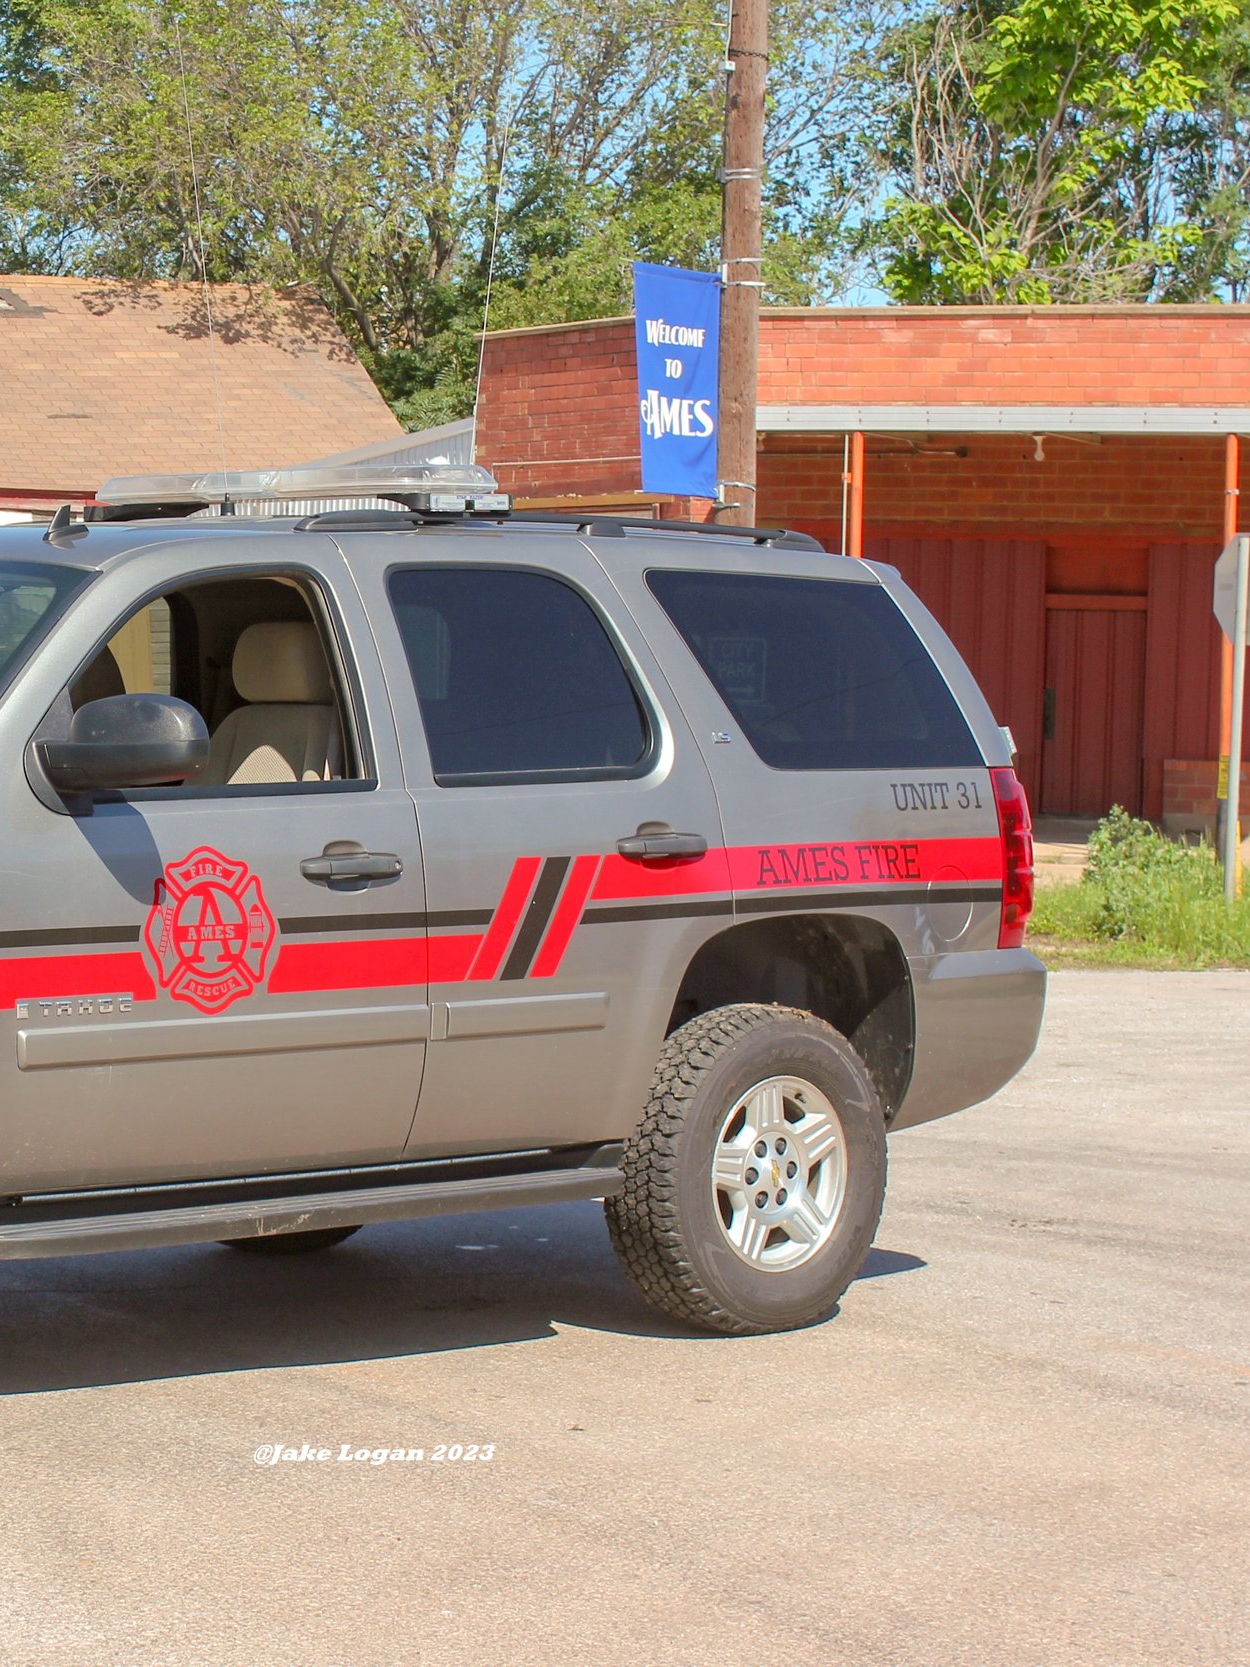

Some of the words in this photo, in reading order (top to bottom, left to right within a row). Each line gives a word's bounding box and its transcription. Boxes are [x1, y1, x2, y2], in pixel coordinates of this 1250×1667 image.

[664, 358, 682, 379] TO
[640, 389, 714, 440] AMES
[890, 782, 949, 811] UNIT
[956, 782, 982, 809] 31
[189, 863, 223, 877] FIRE
[757, 846, 849, 885] AMES
[855, 844, 921, 880] FIRE
[187, 925, 235, 940] AMES
[188, 979, 237, 996] RESCUE
[38, 997, 132, 1018] TAHOE
